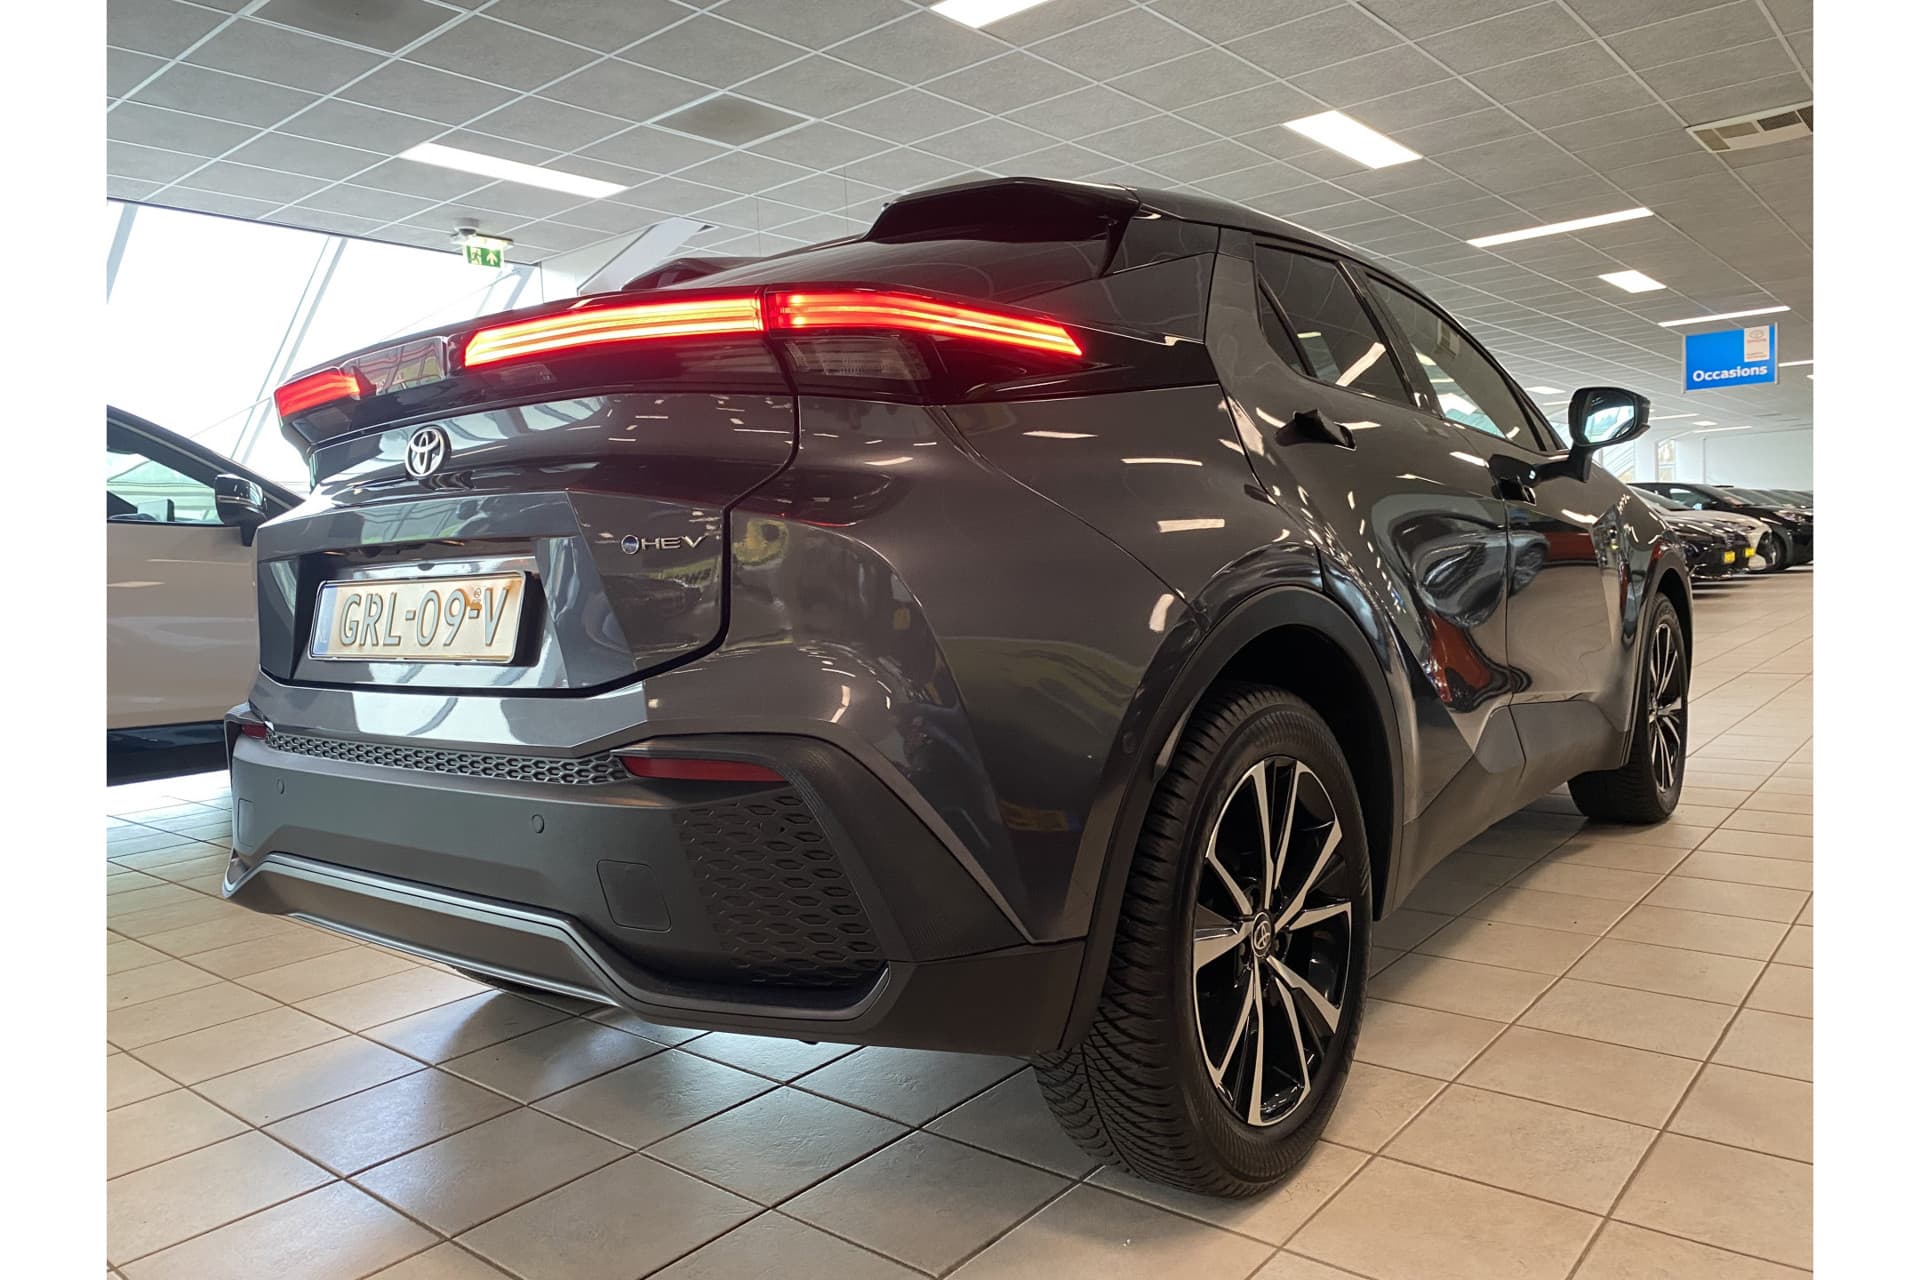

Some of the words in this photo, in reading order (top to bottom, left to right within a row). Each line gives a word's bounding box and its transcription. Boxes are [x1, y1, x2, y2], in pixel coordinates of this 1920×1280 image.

[1692, 365, 1768, 382] Occasions
[641, 535, 708, 550] HEV
[339, 587, 510, 648] GRL-09-V
